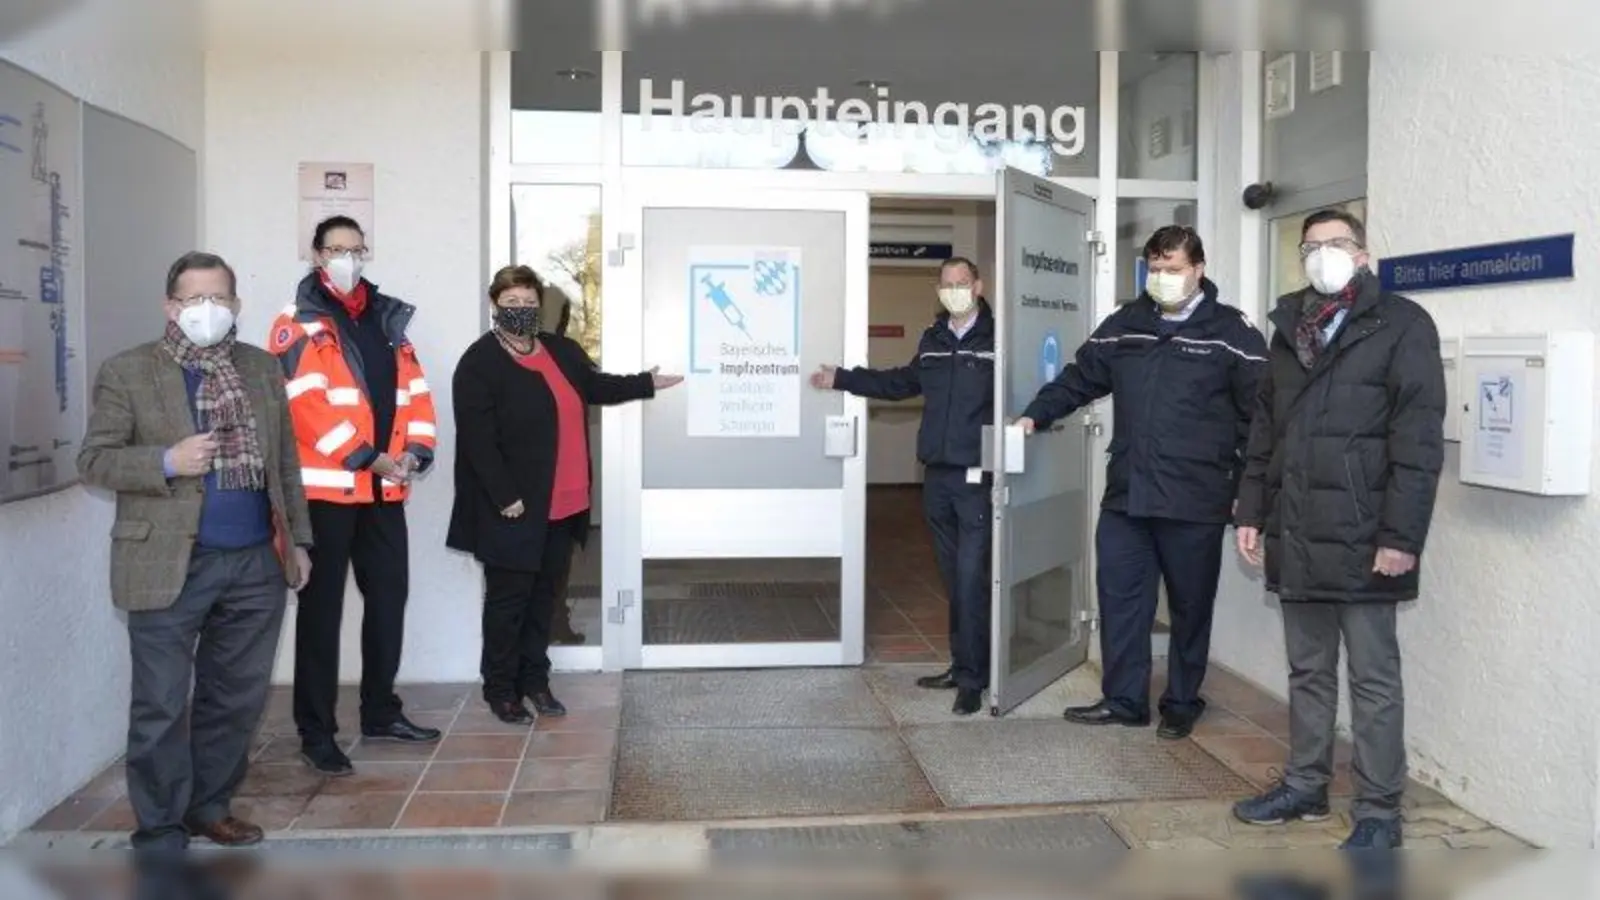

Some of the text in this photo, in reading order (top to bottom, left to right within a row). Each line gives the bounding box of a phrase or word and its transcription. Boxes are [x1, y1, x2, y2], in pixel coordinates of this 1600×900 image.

[639, 78, 1086, 155] Haupteingang
[1394, 252, 1543, 284] Bitte hier anmelden
[720, 361, 799, 377] Impfzentrum
